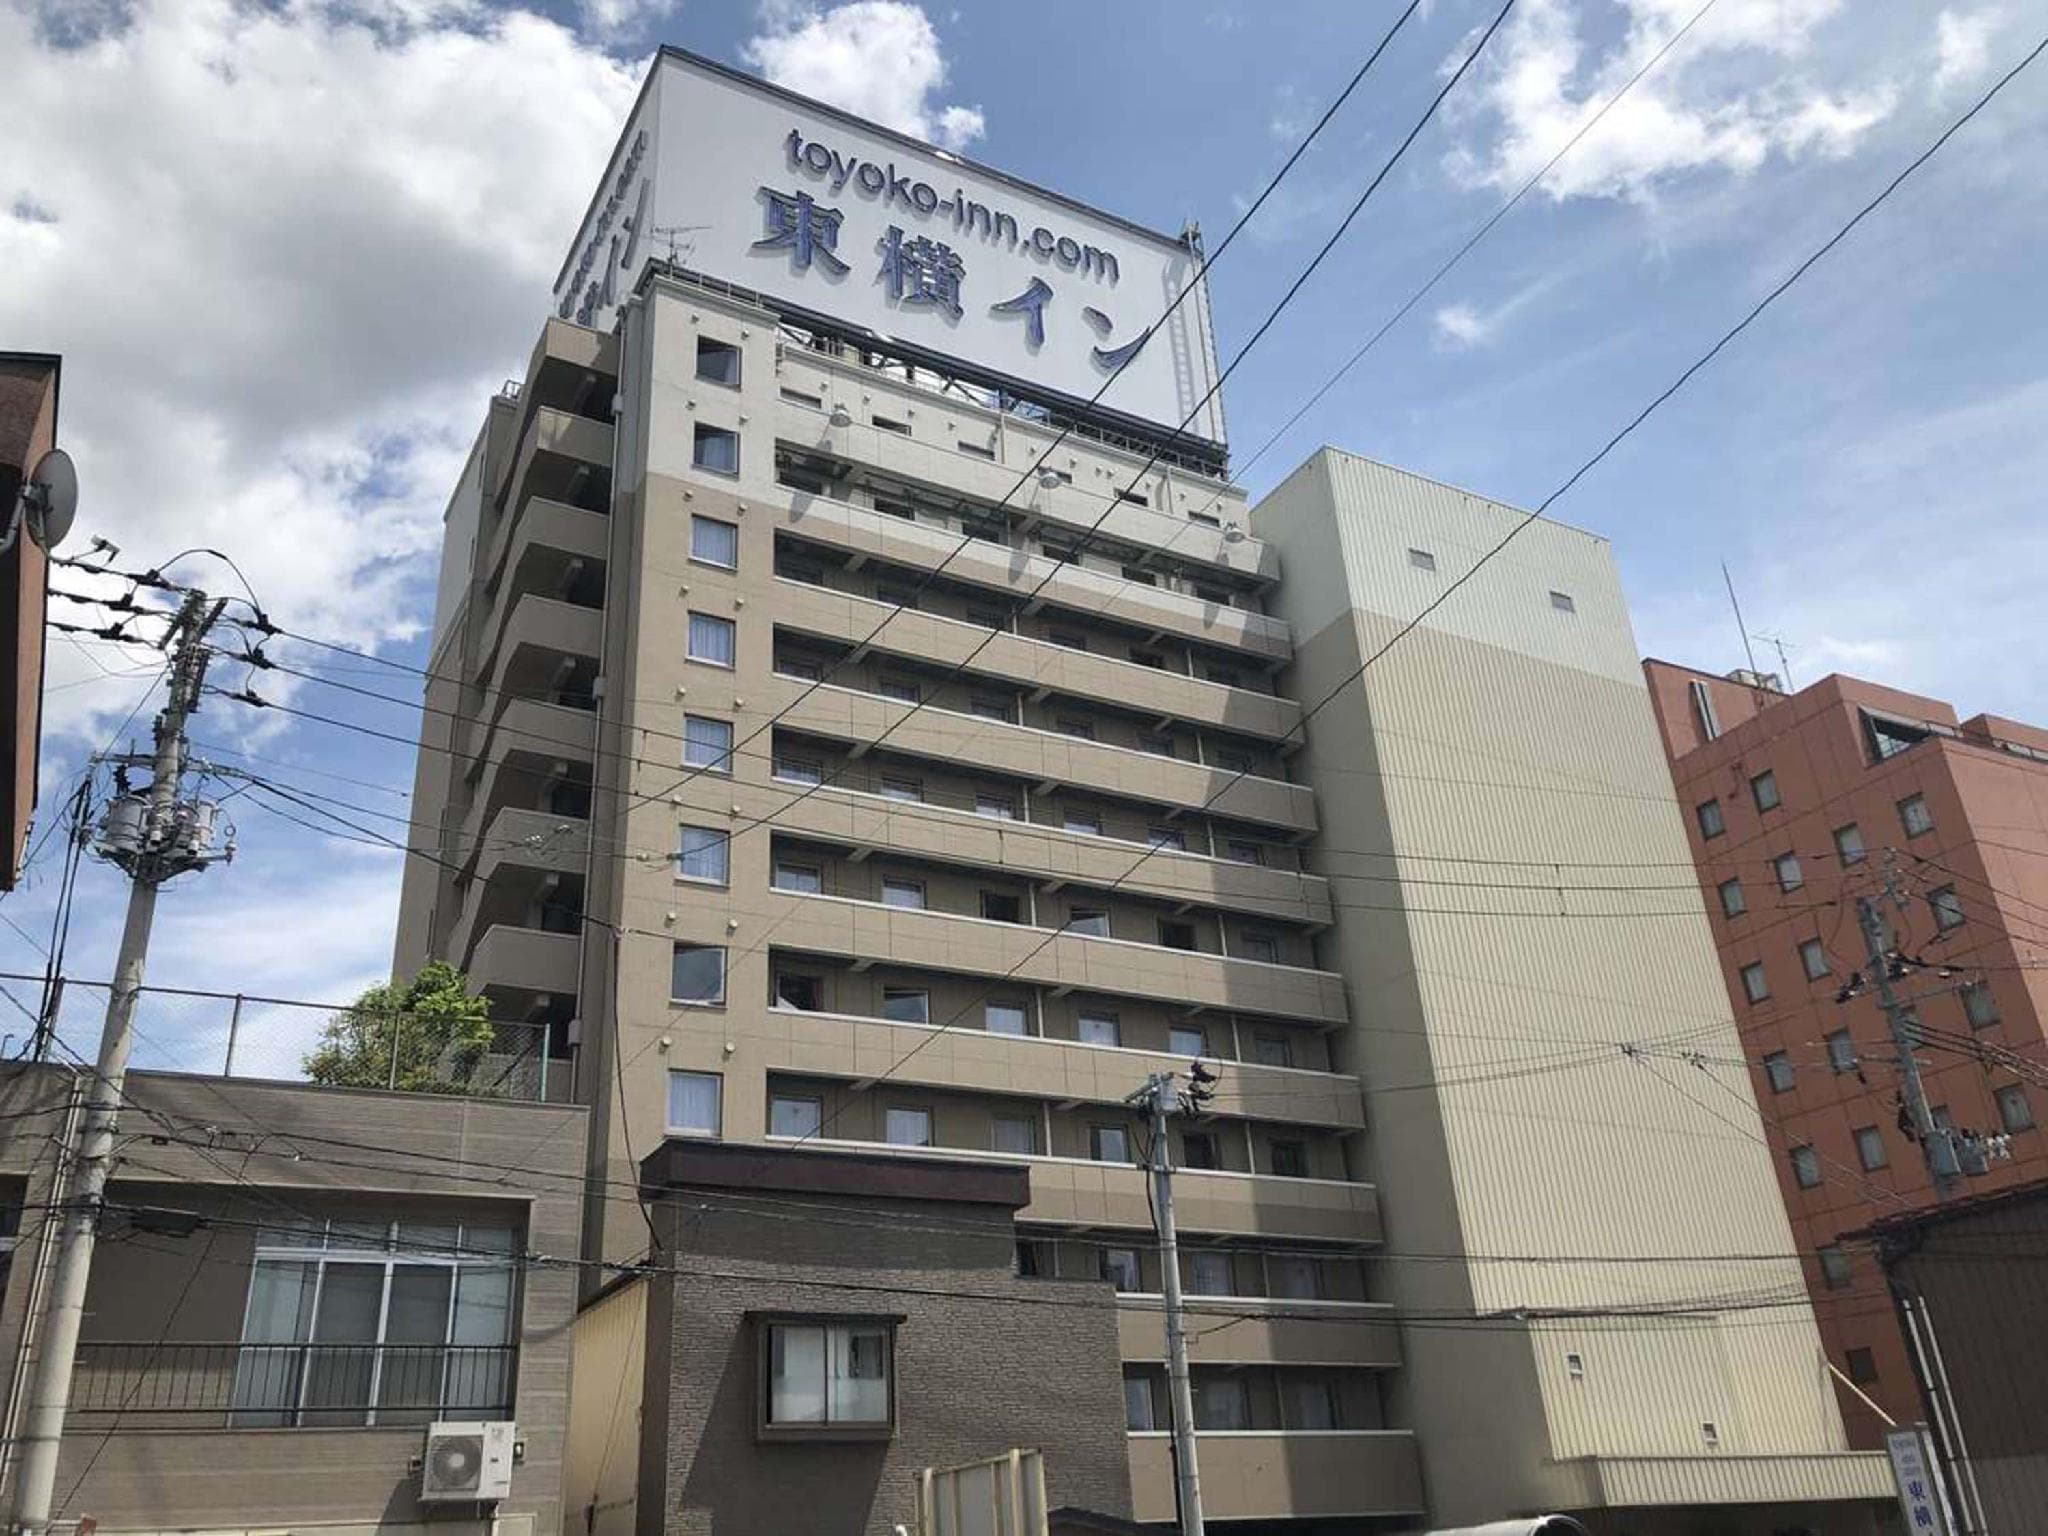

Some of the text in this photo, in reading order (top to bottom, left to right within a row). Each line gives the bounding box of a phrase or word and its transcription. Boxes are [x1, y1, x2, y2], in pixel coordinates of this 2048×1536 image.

[750, 186, 1150, 371] 東横イン
[786, 128, 1120, 284] toyoko-inn.com
